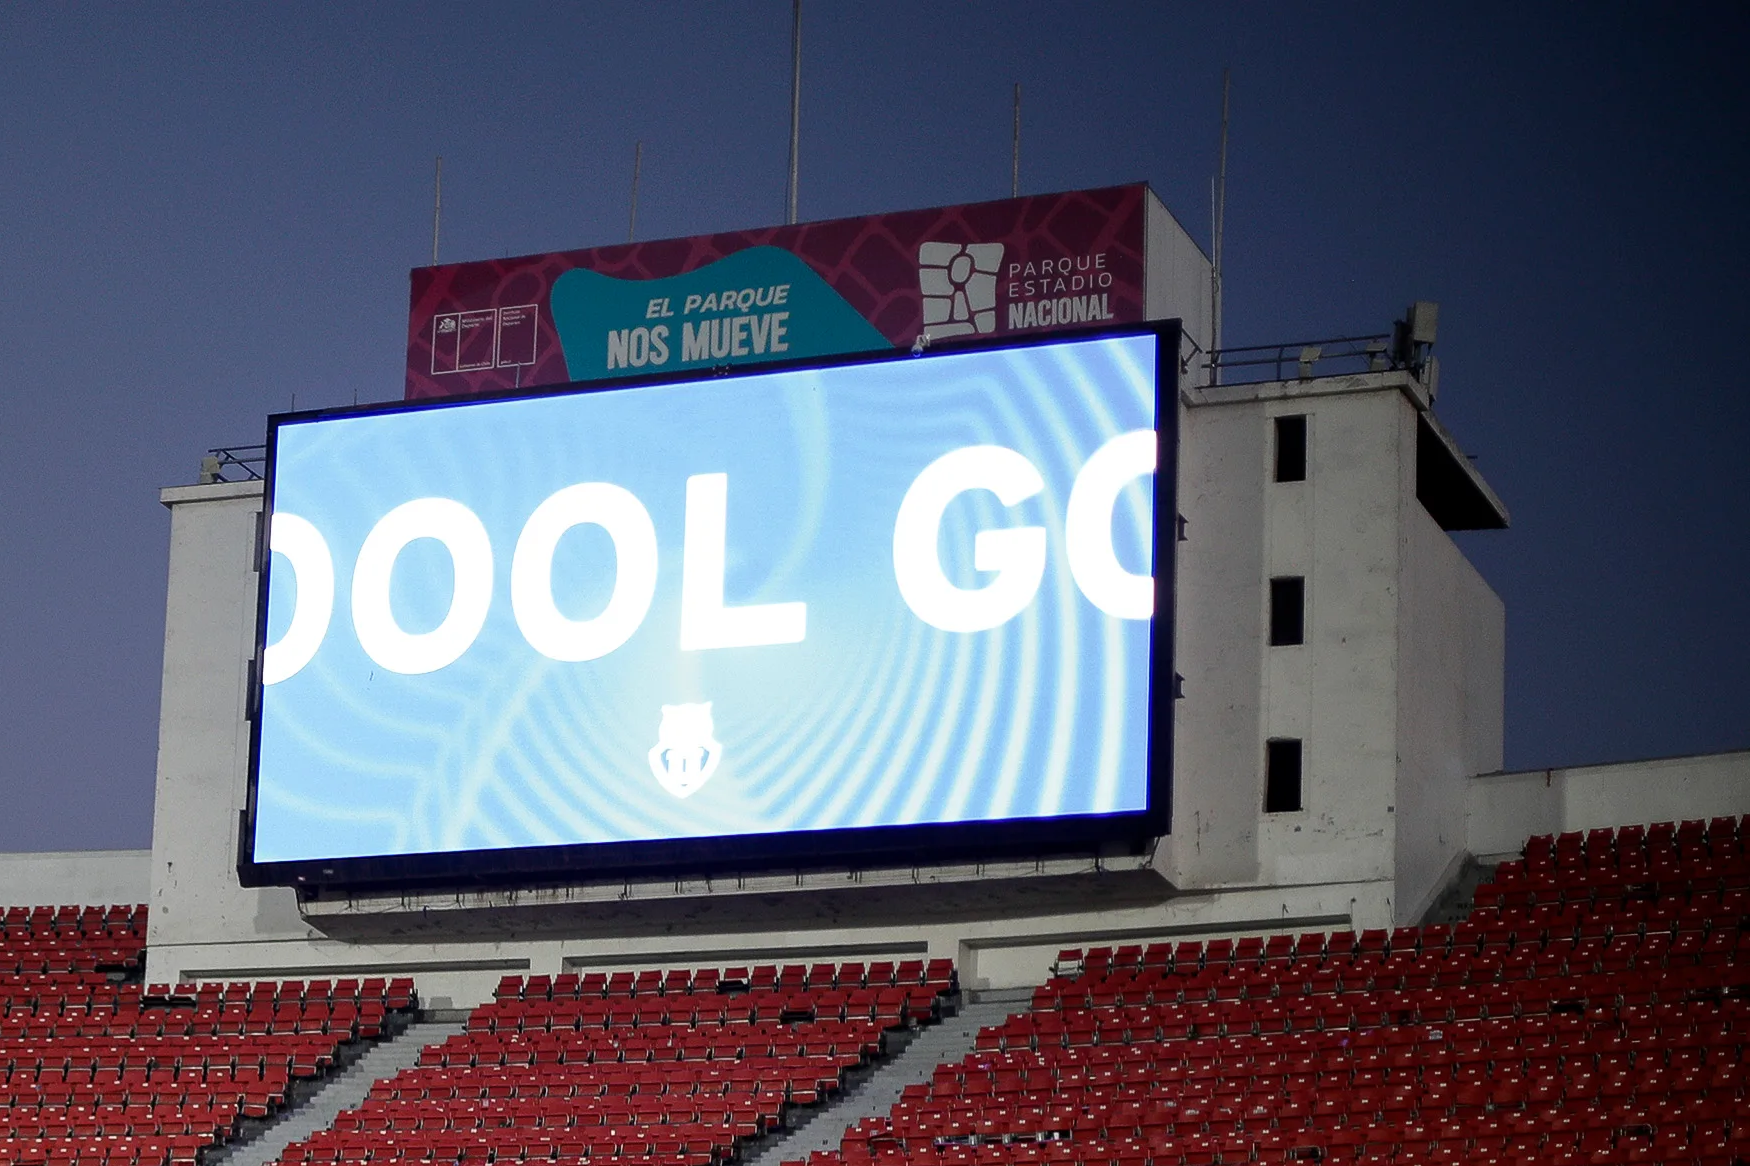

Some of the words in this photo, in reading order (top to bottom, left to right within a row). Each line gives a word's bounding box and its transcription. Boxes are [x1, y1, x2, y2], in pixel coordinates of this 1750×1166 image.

[1008, 253, 1107, 279] PARQUE
[645, 298, 675, 319] EL
[683, 284, 791, 314] PARQUE
[1008, 272, 1113, 298] ESTADIO
[1008, 293, 1114, 330] NACIONAL
[607, 324, 670, 370] NOS
[681, 311, 790, 362] MUEVE
[893, 429, 1157, 633] GO
